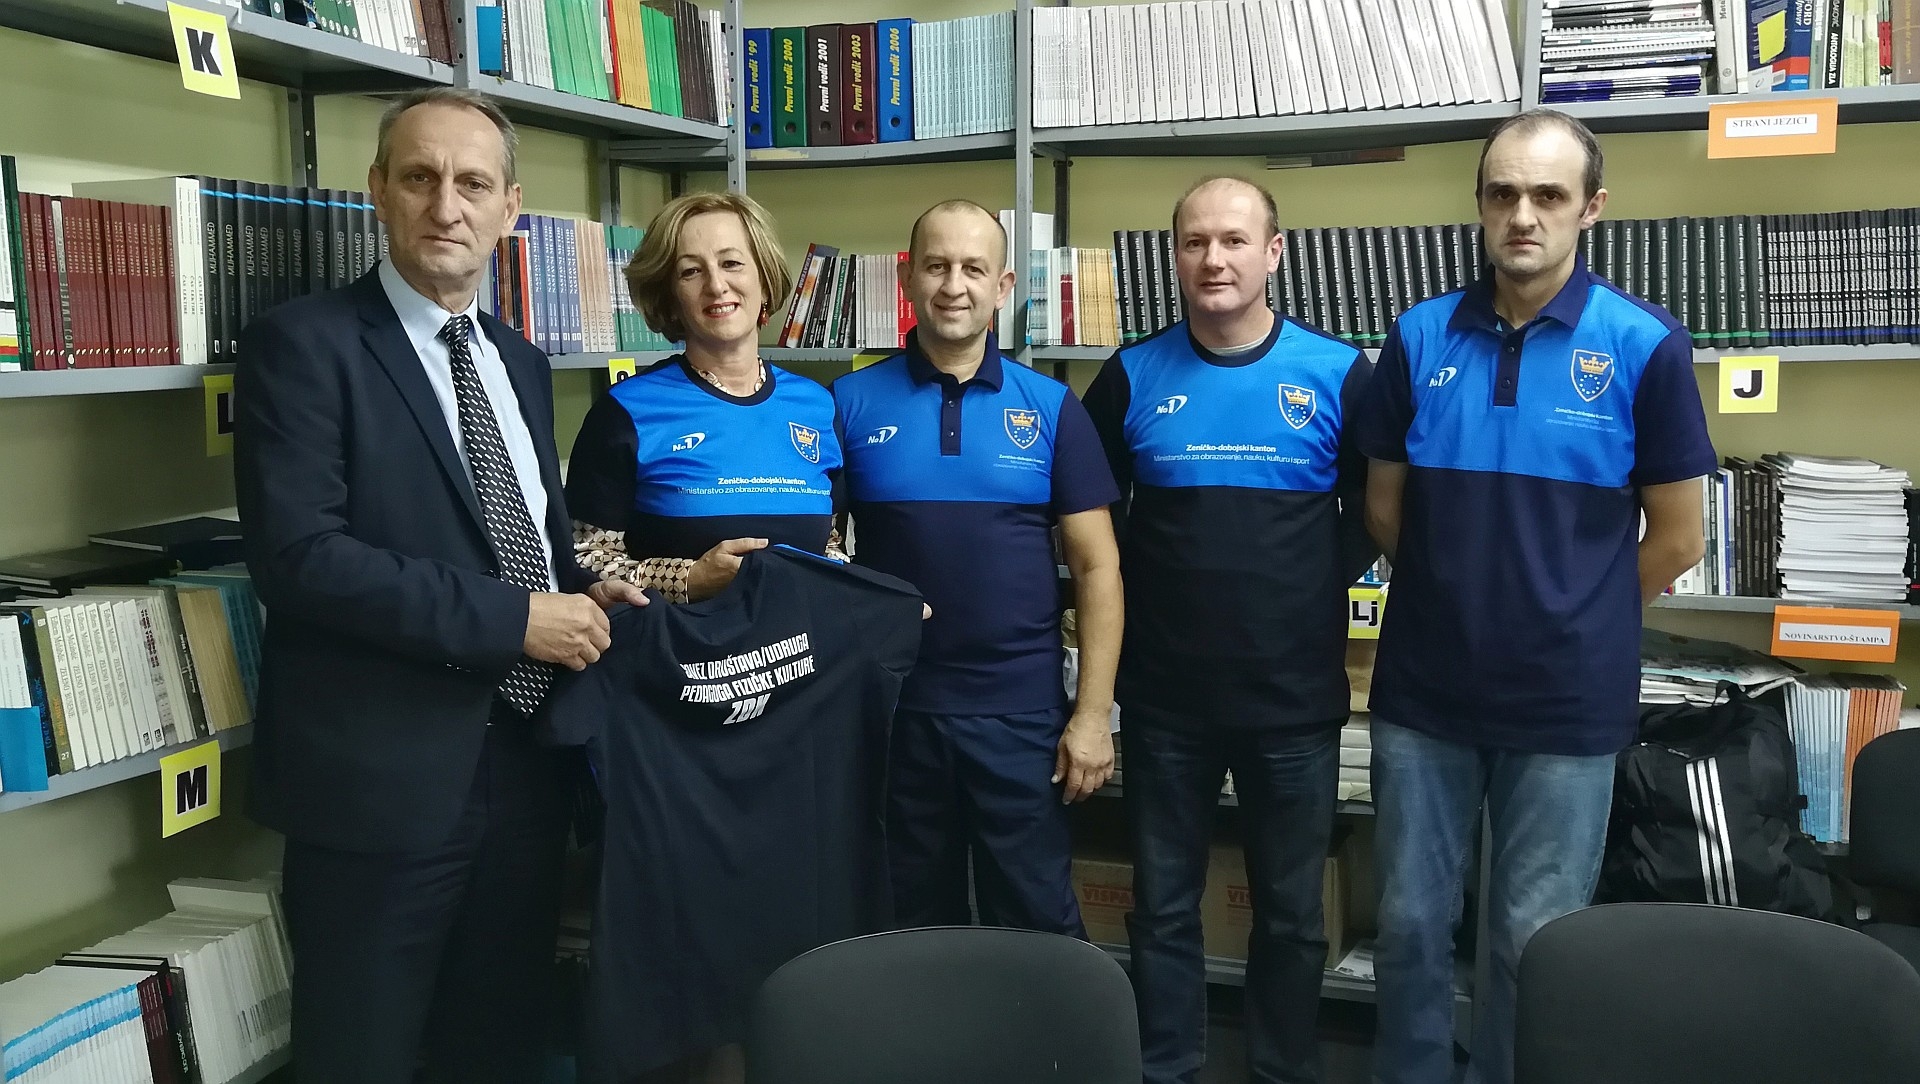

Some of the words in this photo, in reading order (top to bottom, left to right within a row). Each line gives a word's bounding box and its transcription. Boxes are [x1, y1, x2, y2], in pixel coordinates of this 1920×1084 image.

[185, 27, 222, 77] K
[784, 39, 793, 62] 2000
[818, 38, 828, 61] 2001
[852, 35, 862, 58] 2003
[890, 28, 899, 50] 2006
[750, 84, 760, 113] Pravni
[785, 84, 793, 112] Pravni
[820, 84, 829, 112] Pravni
[853, 84, 862, 112] Pravni
[891, 76, 900, 106] Pravni
[1732, 118, 1771, 128] STRANI
[1772, 117, 1808, 126] JEZICI
[207, 222, 217, 274] MUHAMMED
[226, 224, 235, 276] MUHAMMED
[246, 225, 255, 276] MUHAMMED
[260, 227, 269, 276] MUHAMMED
[277, 228, 285, 277] MUHAMMED
[293, 229, 302, 277] MUHAMMED
[316, 231, 324, 278] MUHAMMED
[1733, 370, 1763, 399] J
[1186, 444, 1249, 452] Zeničko-dobojski
[718, 477, 781, 485] Zeničko-dobojski
[1352, 601, 1378, 626] Lj
[1784, 632, 1885, 644] NOVINARSTVO-ŠTAMPA
[708, 632, 810, 679] DRUŠTAVA/UDRUGA
[679, 683, 735, 703] PEDAGOGA
[732, 671, 775, 697] FIZIČKE
[774, 655, 815, 686] KULTURE
[176, 764, 207, 814] M
